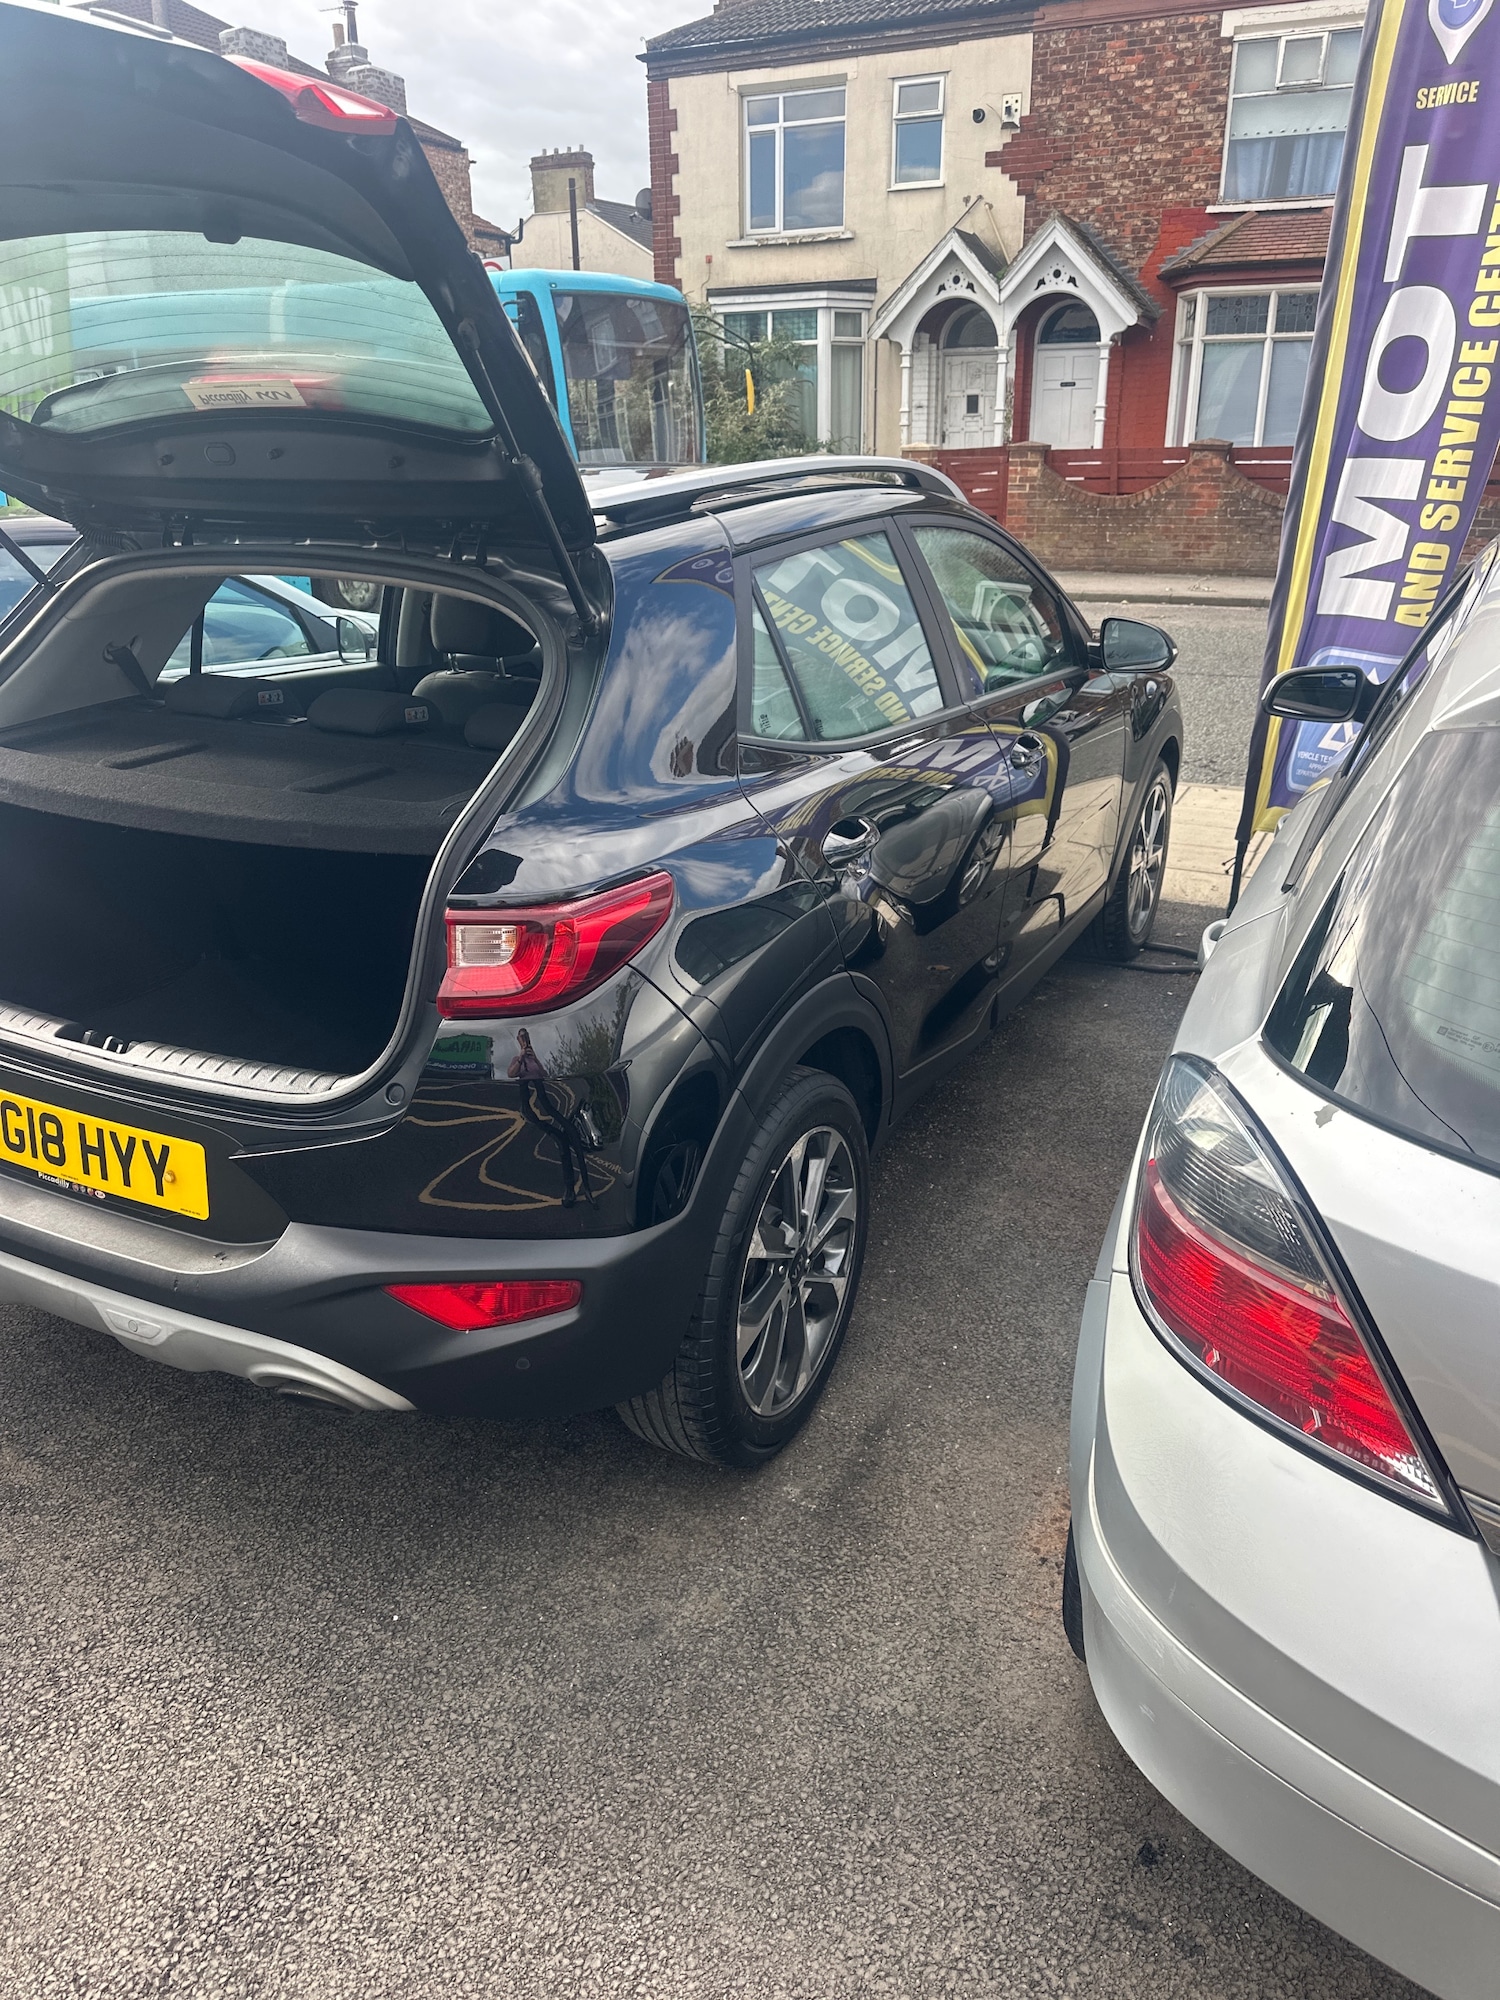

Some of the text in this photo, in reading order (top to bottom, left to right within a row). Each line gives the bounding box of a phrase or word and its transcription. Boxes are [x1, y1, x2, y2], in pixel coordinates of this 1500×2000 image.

[1415, 80, 1480, 110] SERVICE
[1316, 143, 1489, 621] MOT
[1419, 339, 1499, 532] SERVICE
[1393, 541, 1451, 628] AND
[37, 1171, 70, 1189] Piccadilly
[77, 1121, 171, 1198] HYY
